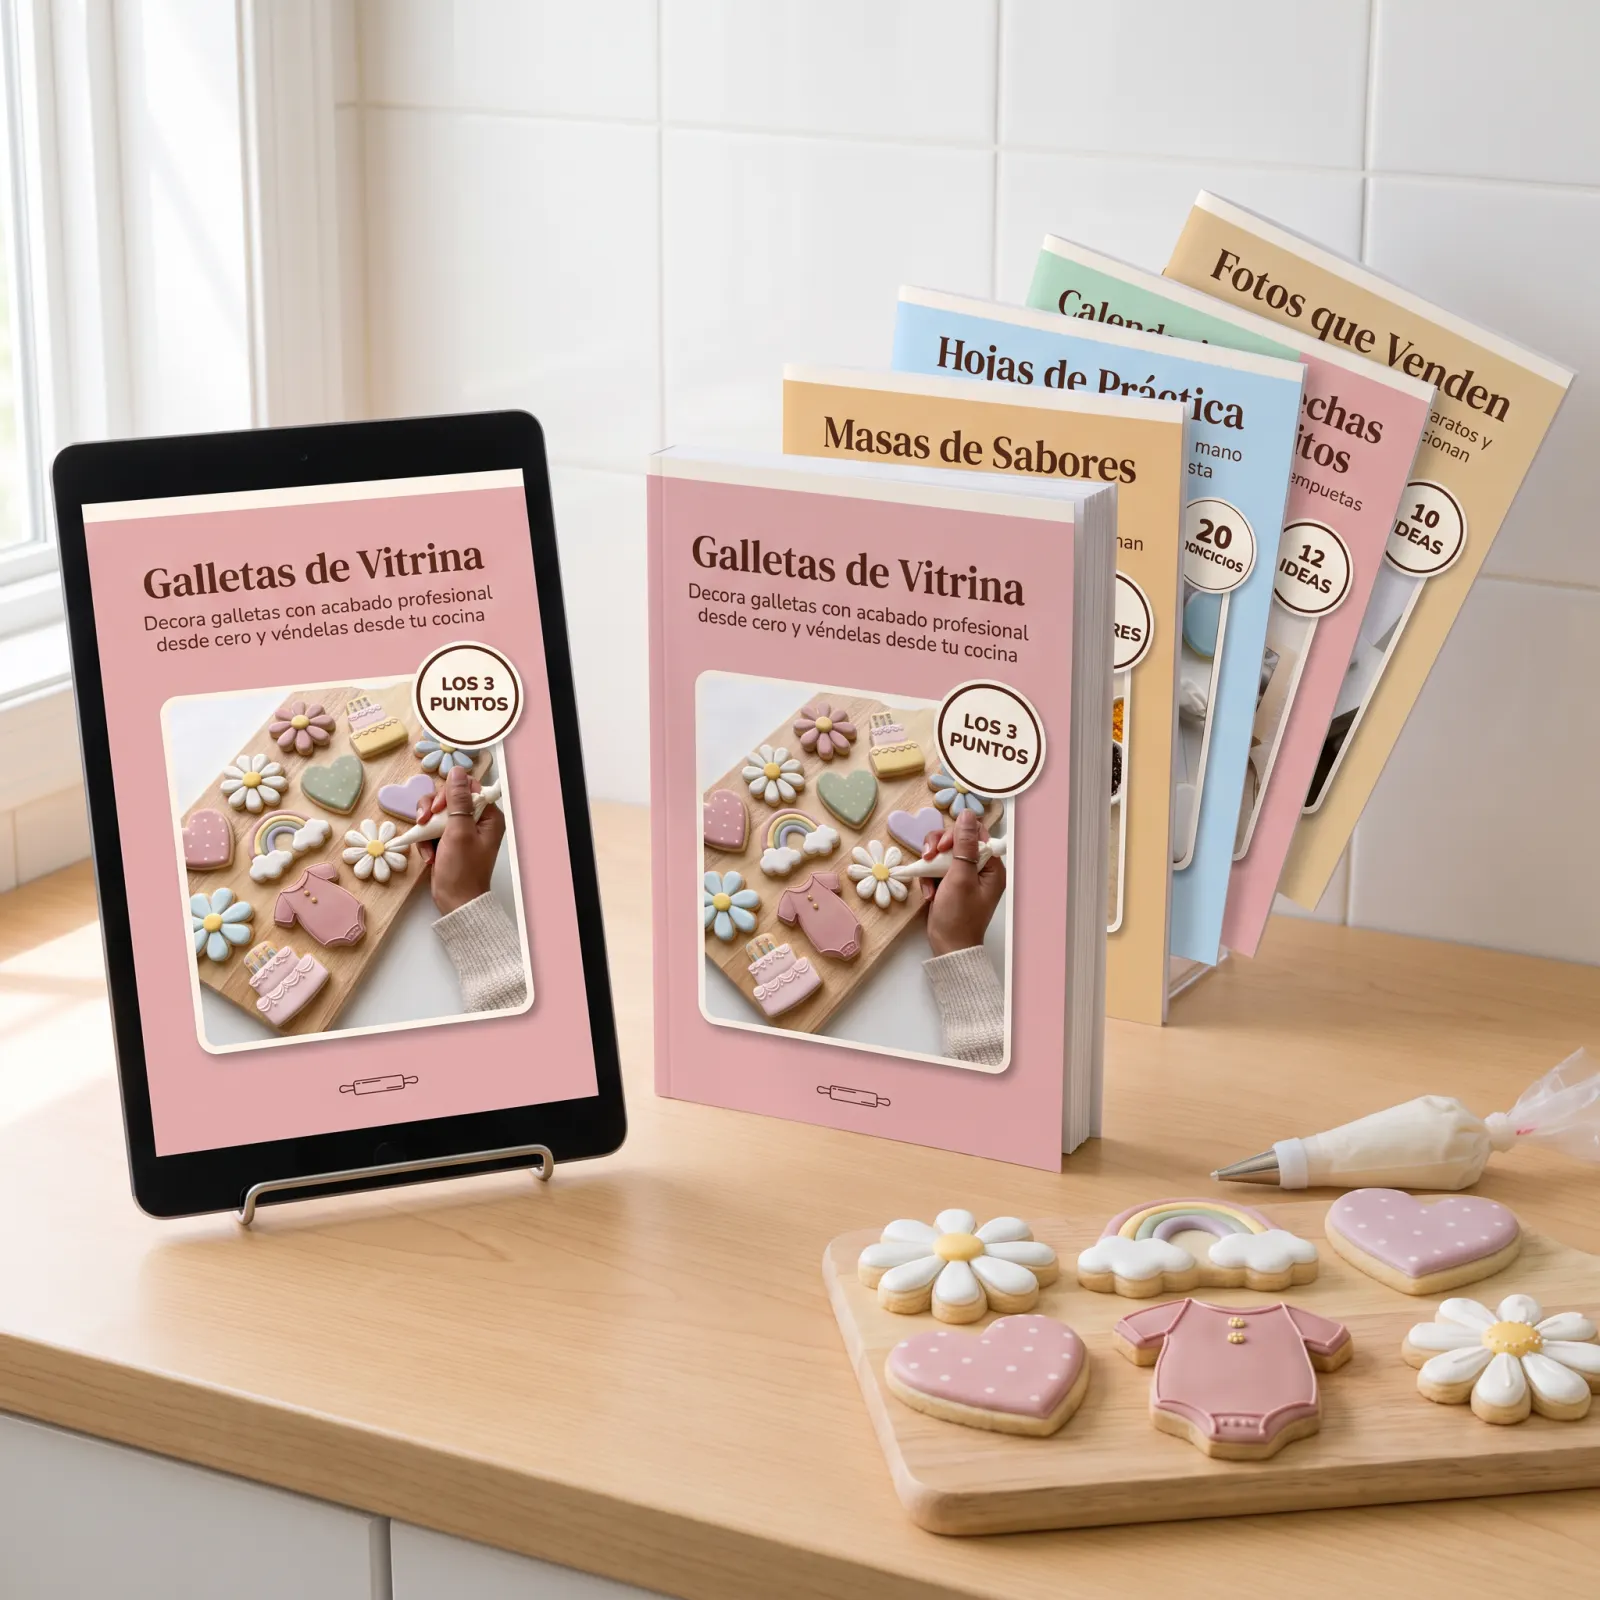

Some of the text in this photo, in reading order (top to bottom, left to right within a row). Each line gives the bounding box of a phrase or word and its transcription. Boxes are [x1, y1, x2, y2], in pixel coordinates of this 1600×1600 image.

[1210, 248, 1510, 422] Fotos que Venden
[937, 336, 1034, 385] Hojas
[1044, 360, 1087, 391] de
[824, 416, 1137, 483] Masas de Sabores
[1195, 441, 1242, 462] mano
[1481, 436, 1493, 450] y
[1196, 518, 1232, 549] 20
[1411, 504, 1440, 529] 10
[143, 542, 485, 599] Galletas de Vitrina
[692, 535, 1025, 606] Galletas de Vitrina
[1298, 544, 1325, 568] 12
[1279, 558, 1333, 594] IDEAS
[144, 585, 493, 631] Decora galletas con acabado profesional
[689, 583, 1029, 641] Decora galletas con acabado profesional
[156, 608, 485, 652] desde cero y véndelas desde tu cocina
[698, 608, 1018, 663] desde cero y véndelas desde tu cocina
[441, 676, 495, 691] LOS 3
[430, 697, 509, 712] PUNTOS
[964, 713, 1018, 740] LOS 3
[949, 733, 1029, 766] PUNTOS
